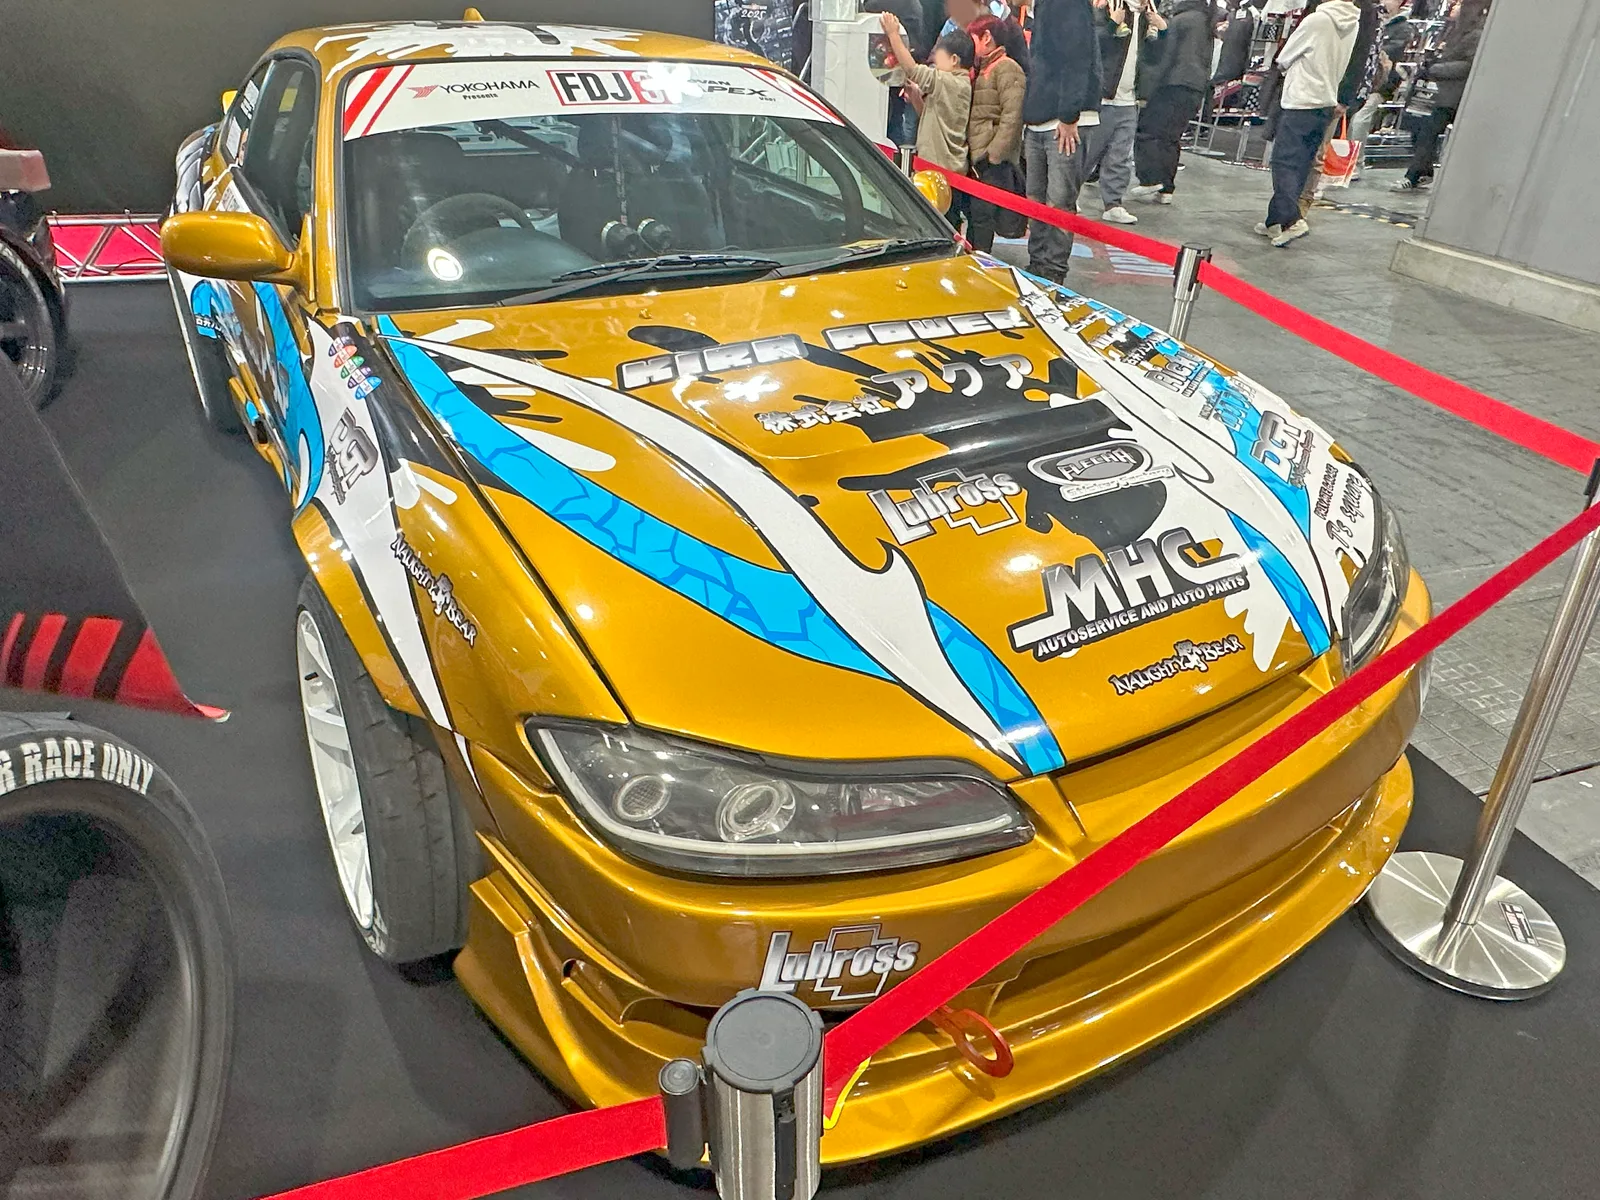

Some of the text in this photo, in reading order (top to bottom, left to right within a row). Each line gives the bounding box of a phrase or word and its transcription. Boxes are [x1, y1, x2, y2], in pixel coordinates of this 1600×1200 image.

[740, 9, 767, 20] 2025
[441, 79, 540, 94] YOKOHAMA
[462, 92, 498, 101] Presents
[619, 335, 804, 389] KIRA
[824, 307, 1033, 350] POWER
[1057, 448, 1138, 481] FLECHA
[869, 472, 1024, 545] Lubross
[390, 531, 478, 648] NAUGHTY BEAR
[1012, 531, 1245, 648] MHC
[1037, 575, 1246, 657] AUTOSERVICE AND AUTO PARTS
[1110, 636, 1245, 694] NAUGHTY BEAR
[20, 736, 95, 785] RACE
[101, 742, 153, 795] ONLY
[759, 931, 921, 992] Lubross
